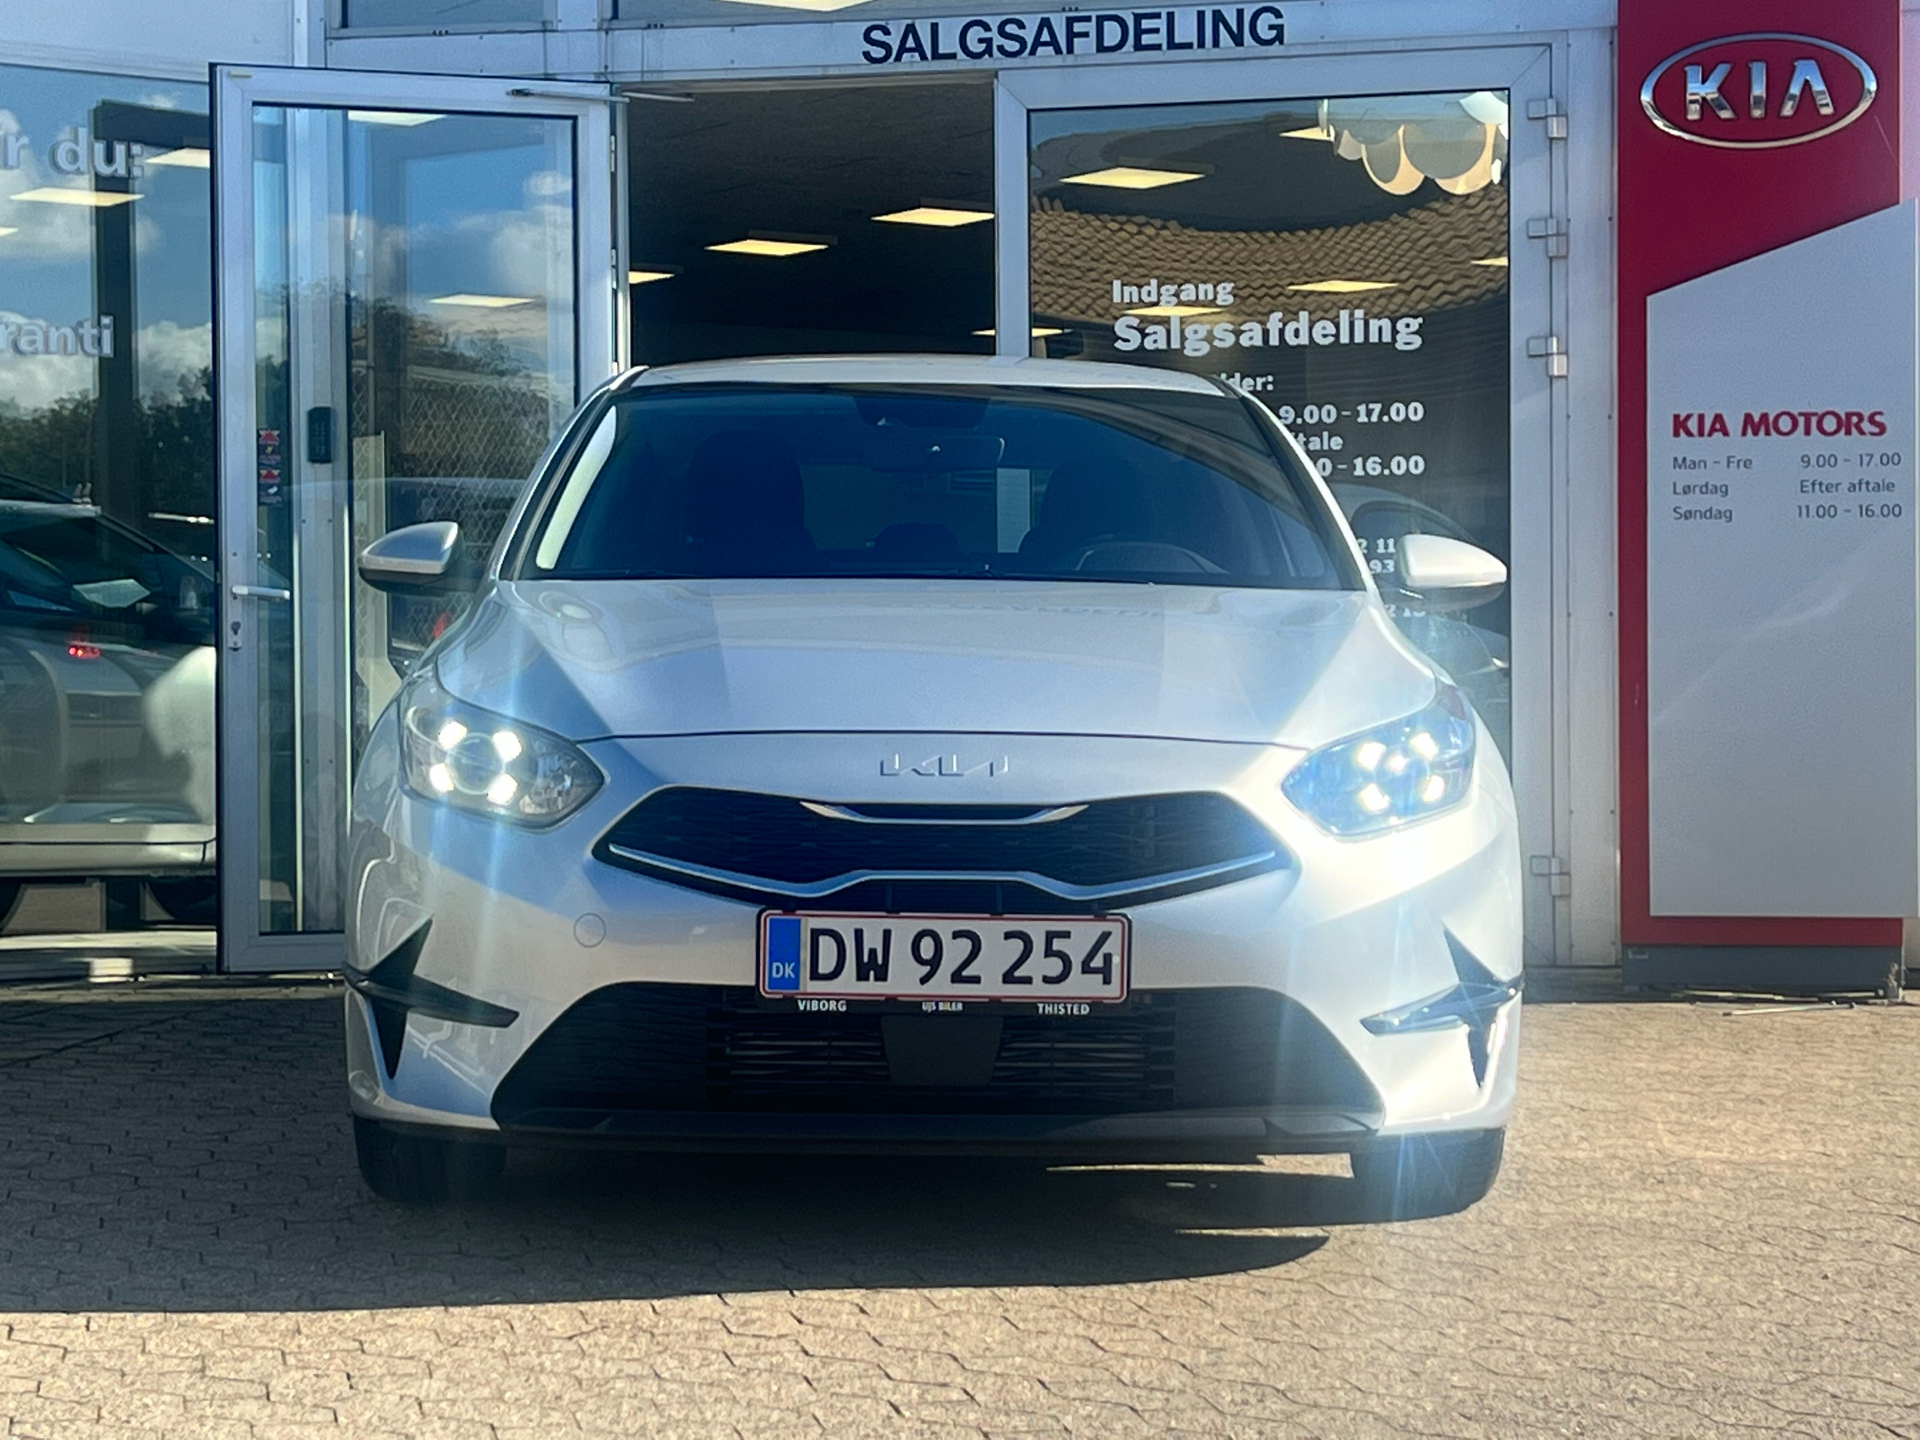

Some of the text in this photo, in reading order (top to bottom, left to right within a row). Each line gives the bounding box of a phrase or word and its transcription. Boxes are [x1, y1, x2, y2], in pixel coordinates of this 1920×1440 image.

[862, 6, 1285, 65] SALGSAFDELING
[1684, 59, 1835, 120] KIA
[55, 127, 144, 178] du:
[1112, 278, 1235, 307] Indgang
[1113, 308, 1424, 357] Salgsafdeling
[1671, 409, 1888, 438] KIA MOTORS
[1291, 431, 1344, 451] tale
[1672, 456, 1708, 471] Man
[1726, 455, 1754, 470] Fre
[1800, 453, 1838, 469] 9.00
[1857, 452, 1902, 468] 17.00
[1672, 481, 1730, 497] Lørdag
[1799, 477, 1896, 494] Efter aftale
[1672, 506, 1734, 523] Søndag
[1797, 503, 1838, 519] 11.00
[1858, 503, 1903, 519] 16.00
[879, 753, 1009, 777] KIA
[809, 928, 1113, 986] DW 92 254
[771, 961, 796, 979] DK
[797, 999, 847, 1012] VIBORG
[1037, 1003, 1091, 1015] THISTED
